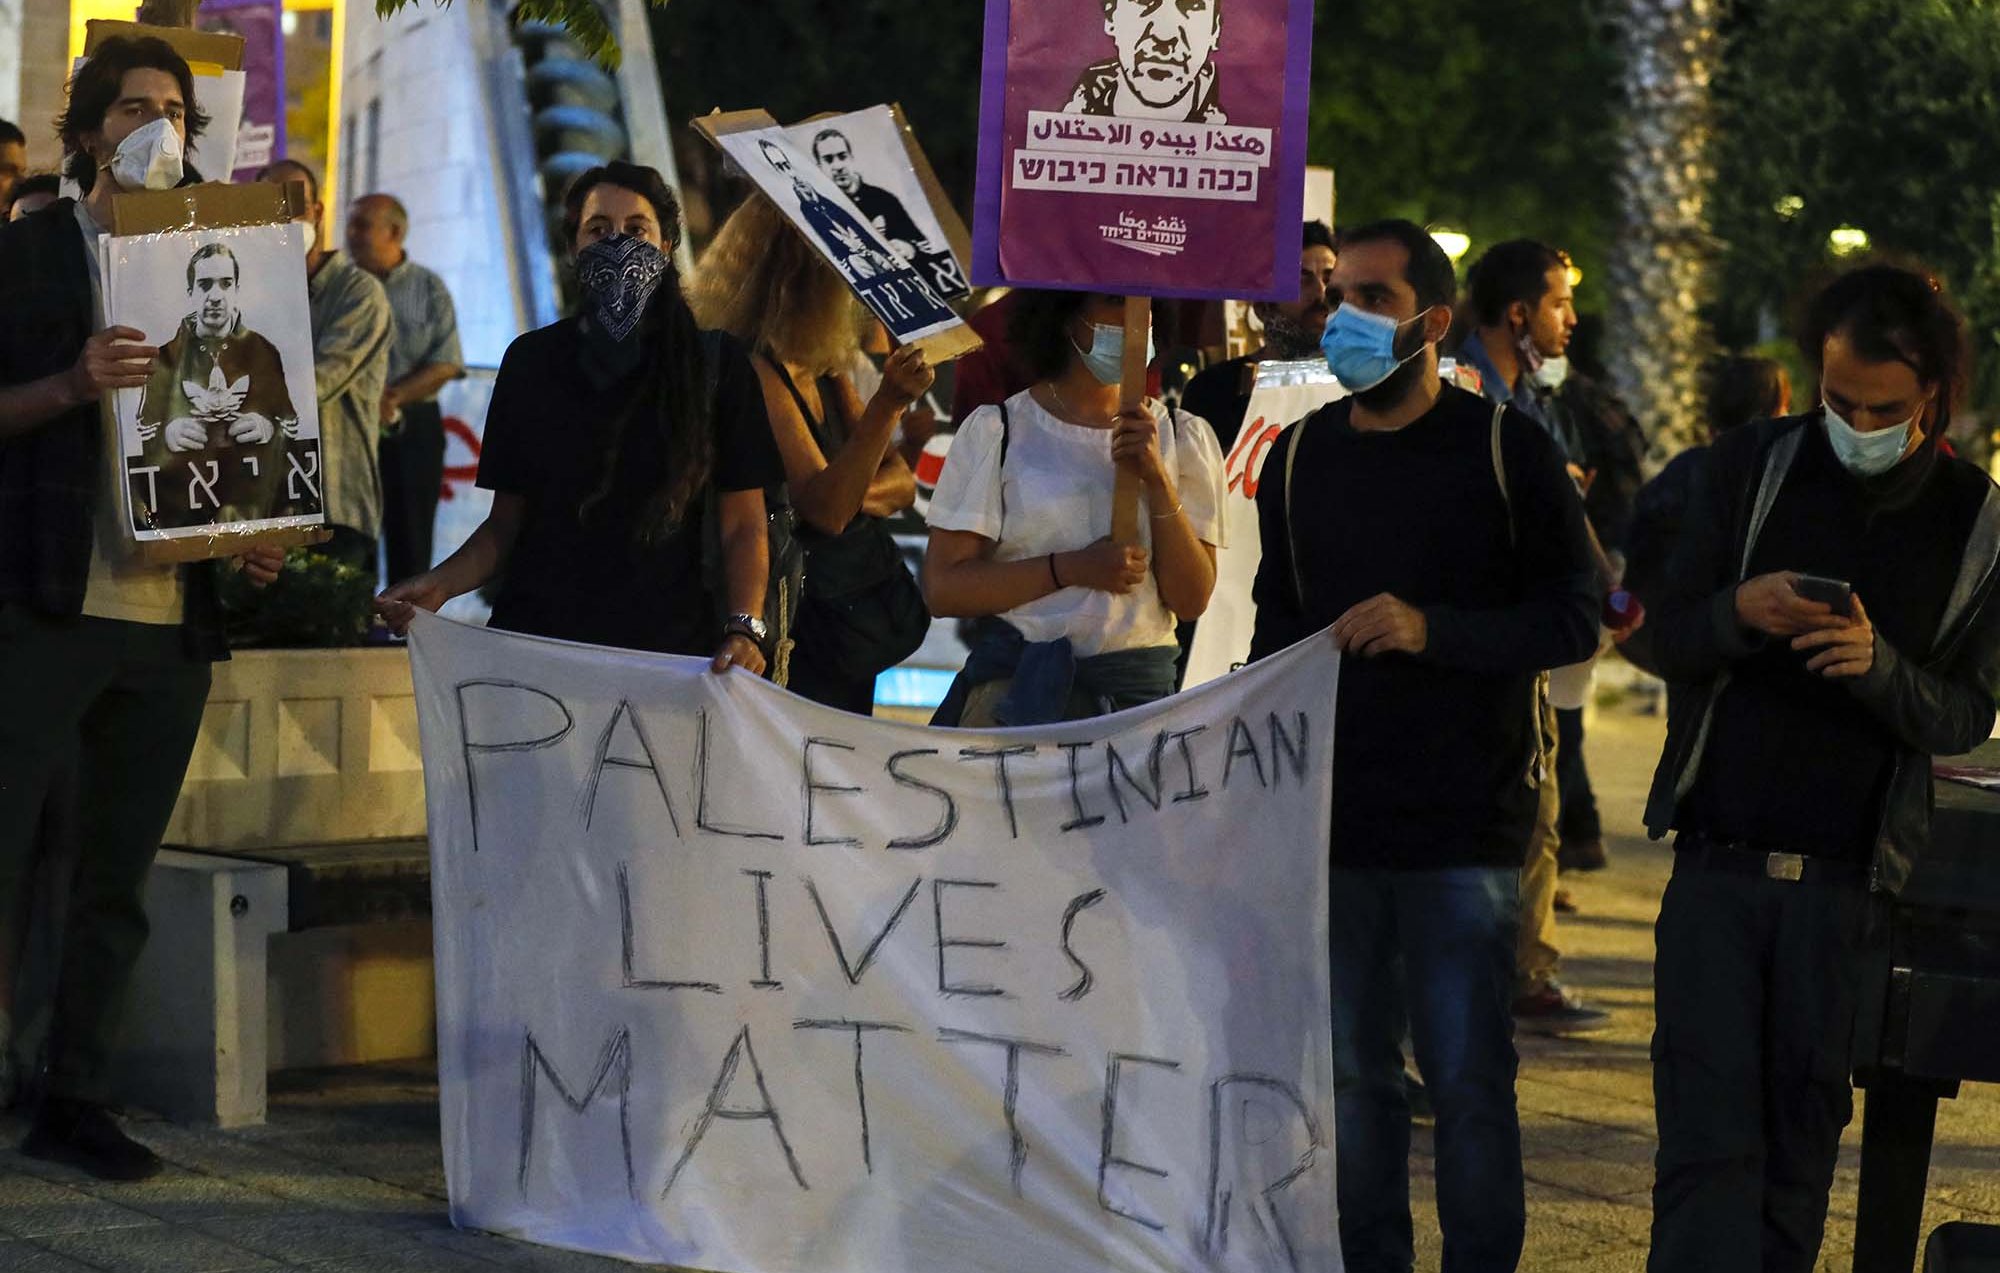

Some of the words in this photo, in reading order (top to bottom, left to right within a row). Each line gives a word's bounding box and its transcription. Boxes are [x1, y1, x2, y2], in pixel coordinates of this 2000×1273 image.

[1033, 118, 1132, 144] الاحتلال
[1139, 129, 1197, 157] يبدو
[1205, 130, 1266, 156] هكذا
[1018, 157, 1107, 184] כיבוש
[1115, 163, 1188, 188] נראה
[1197, 167, 1254, 192] ככה
[1098, 225, 1133, 239] ביחד
[1136, 229, 1187, 245] עומדים
[1151, 215, 1187, 233] نقف
[455, 678, 1310, 852] PALESTINIAN
[614, 861, 1108, 1000] LIVES
[517, 1018, 1326, 1273] MATTER
